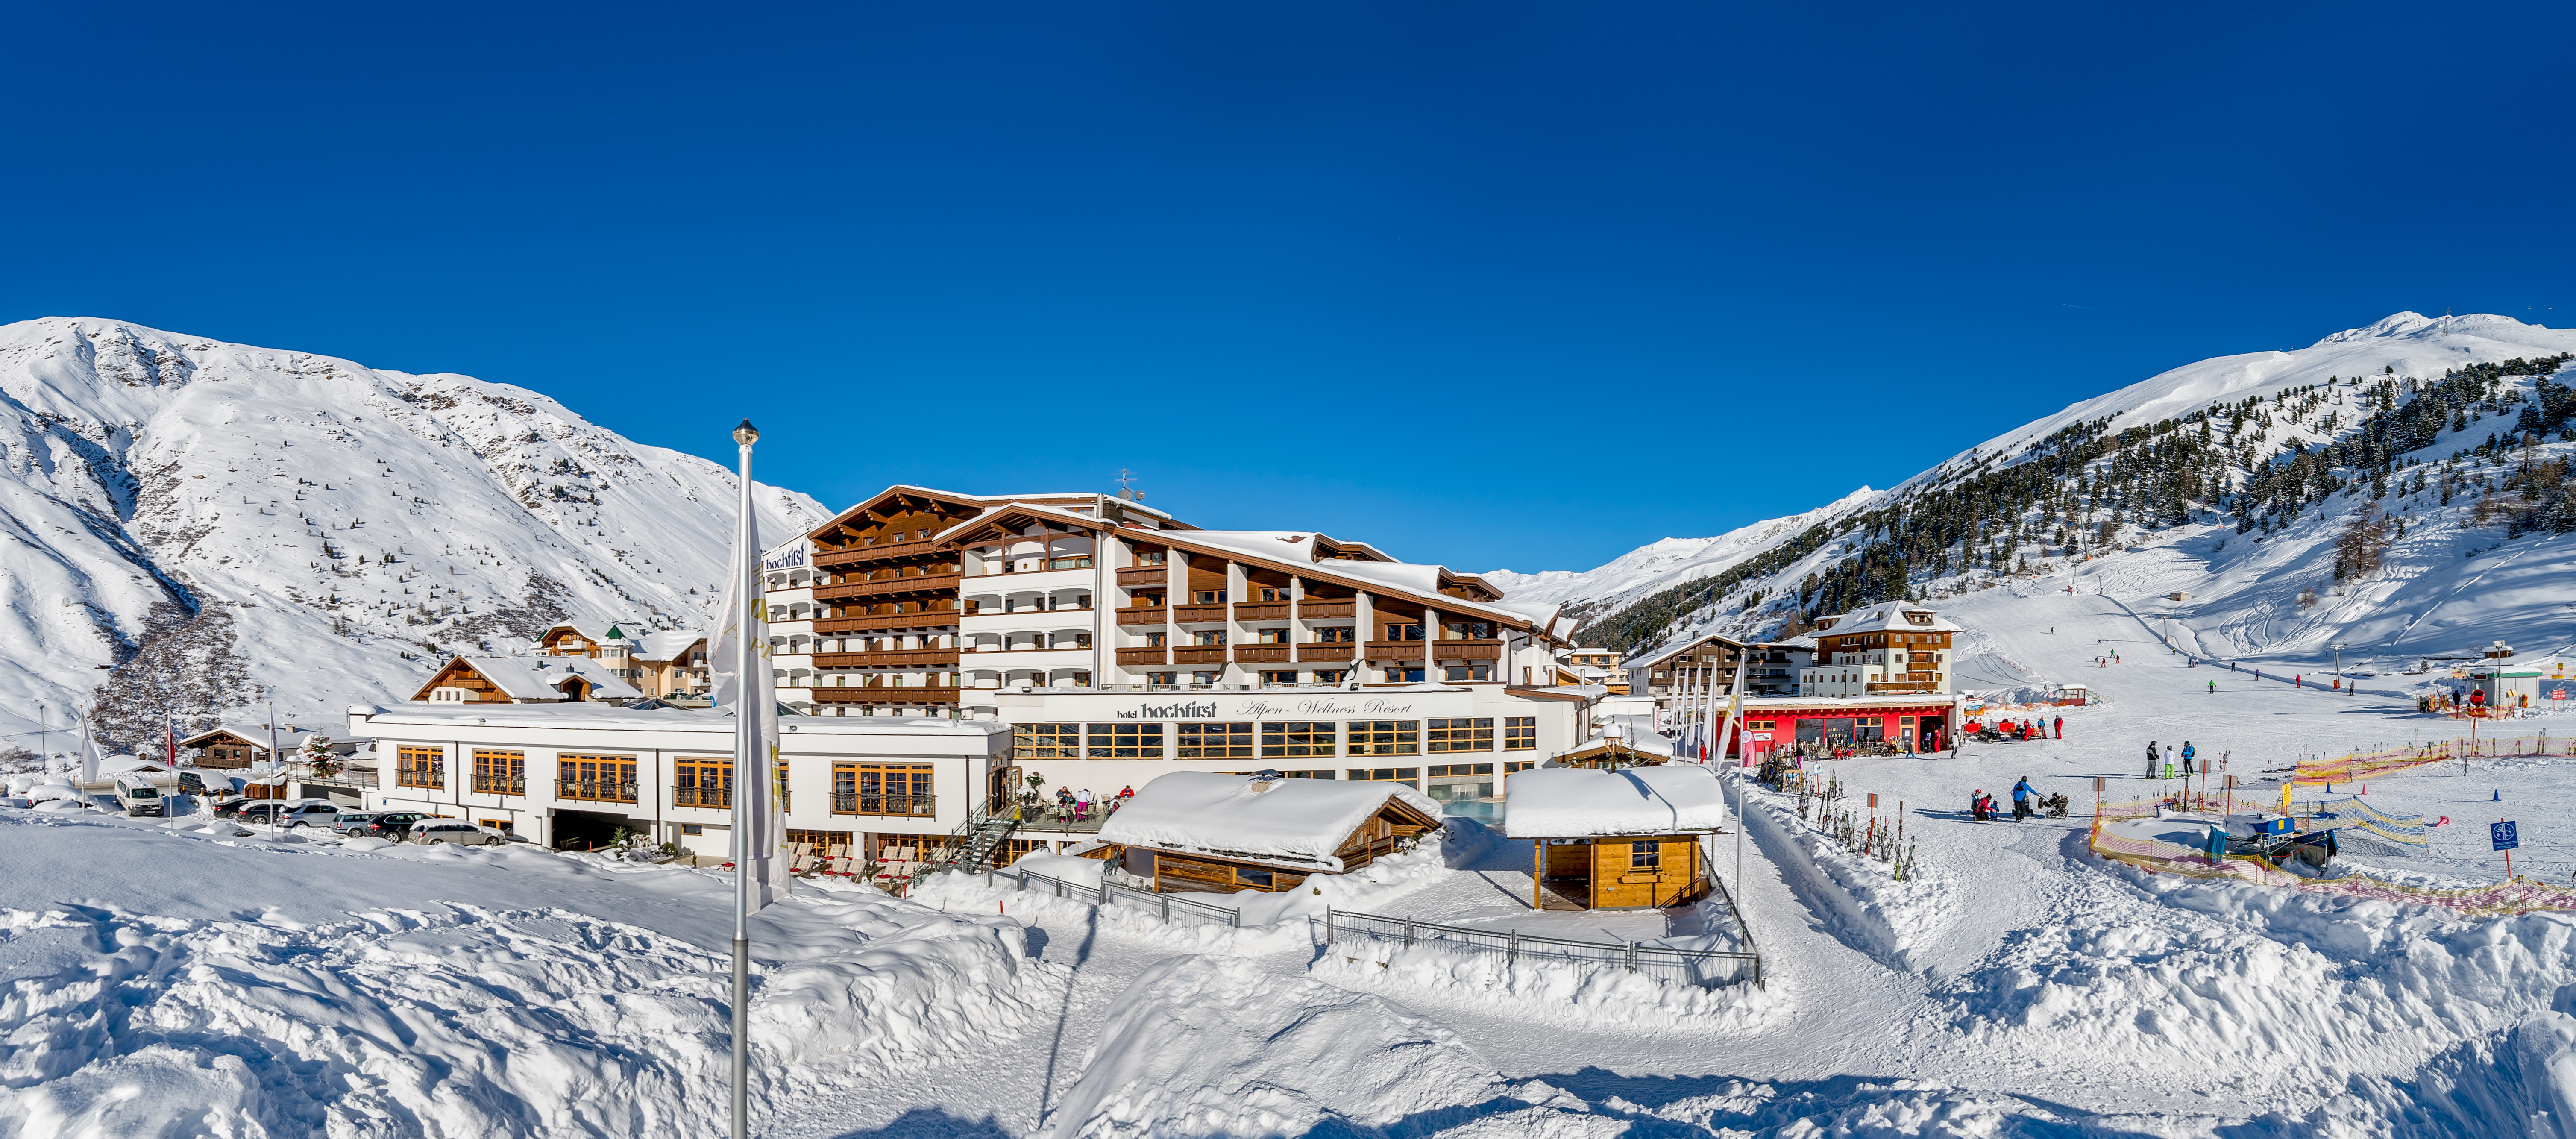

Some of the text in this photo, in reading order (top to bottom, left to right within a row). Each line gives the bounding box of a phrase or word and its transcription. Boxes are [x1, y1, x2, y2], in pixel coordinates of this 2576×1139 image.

[766, 541, 804, 570] hochfirst
[1117, 710, 1137, 718] hotel
[1140, 700, 1217, 718] hochfirst
[1297, 698, 1356, 715] Wellness
[1364, 699, 1412, 714] Resort
